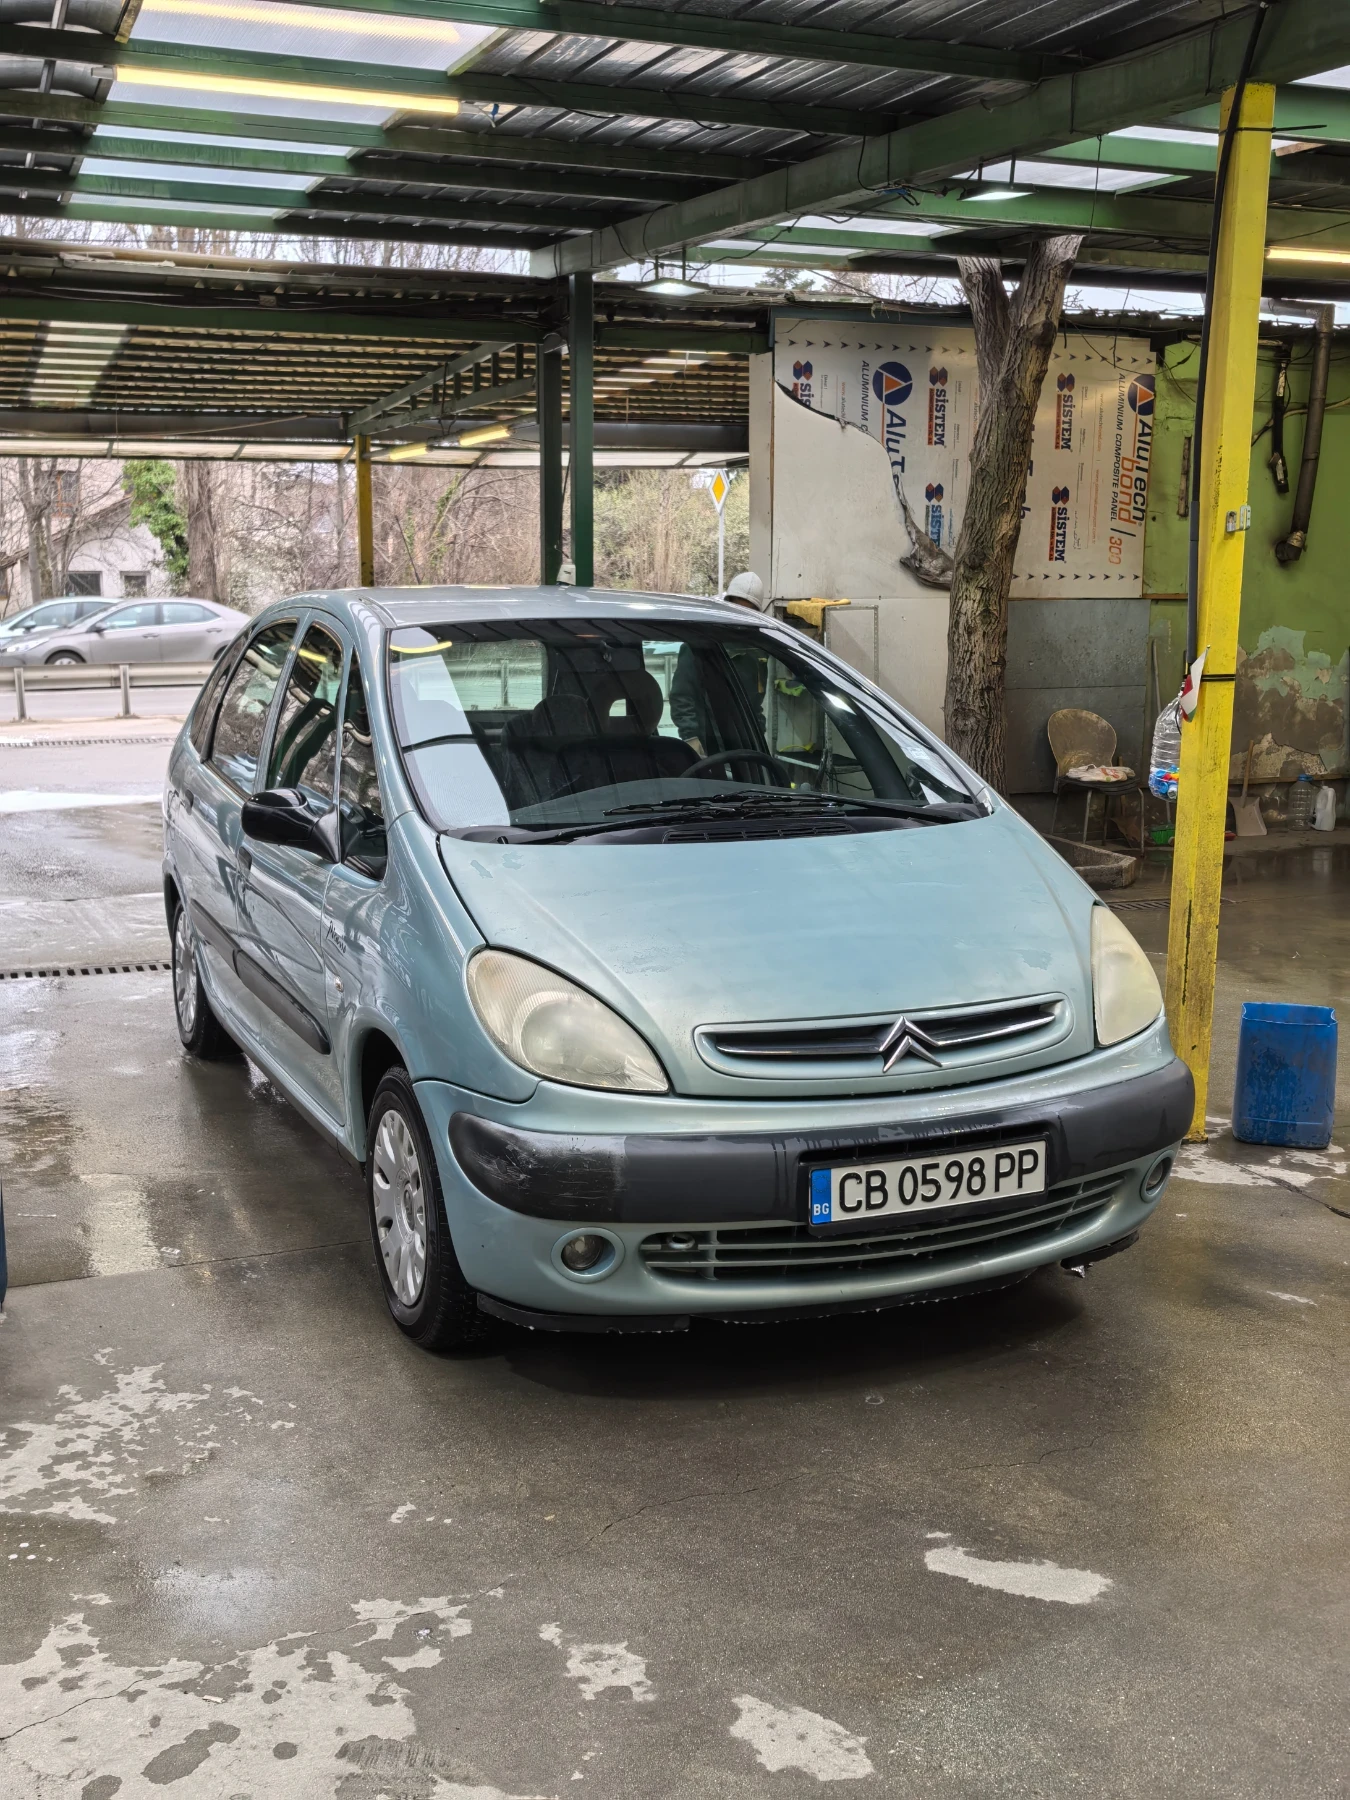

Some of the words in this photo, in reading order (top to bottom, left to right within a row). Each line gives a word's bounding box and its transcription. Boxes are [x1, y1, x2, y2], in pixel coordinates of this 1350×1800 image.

[861, 360, 870, 421] ALUMINIUM
[1115, 372, 1126, 431] ALUMINIUM
[1112, 433, 1123, 488] COMPOSITE
[1110, 491, 1119, 522] PANEL
[1118, 456, 1141, 525] bond
[1108, 535, 1123, 565] 300
[813, 1202, 830, 1216] BG
[839, 1169, 889, 1214] CB
[898, 1156, 986, 1206] 0598
[994, 1148, 1039, 1193] PP
